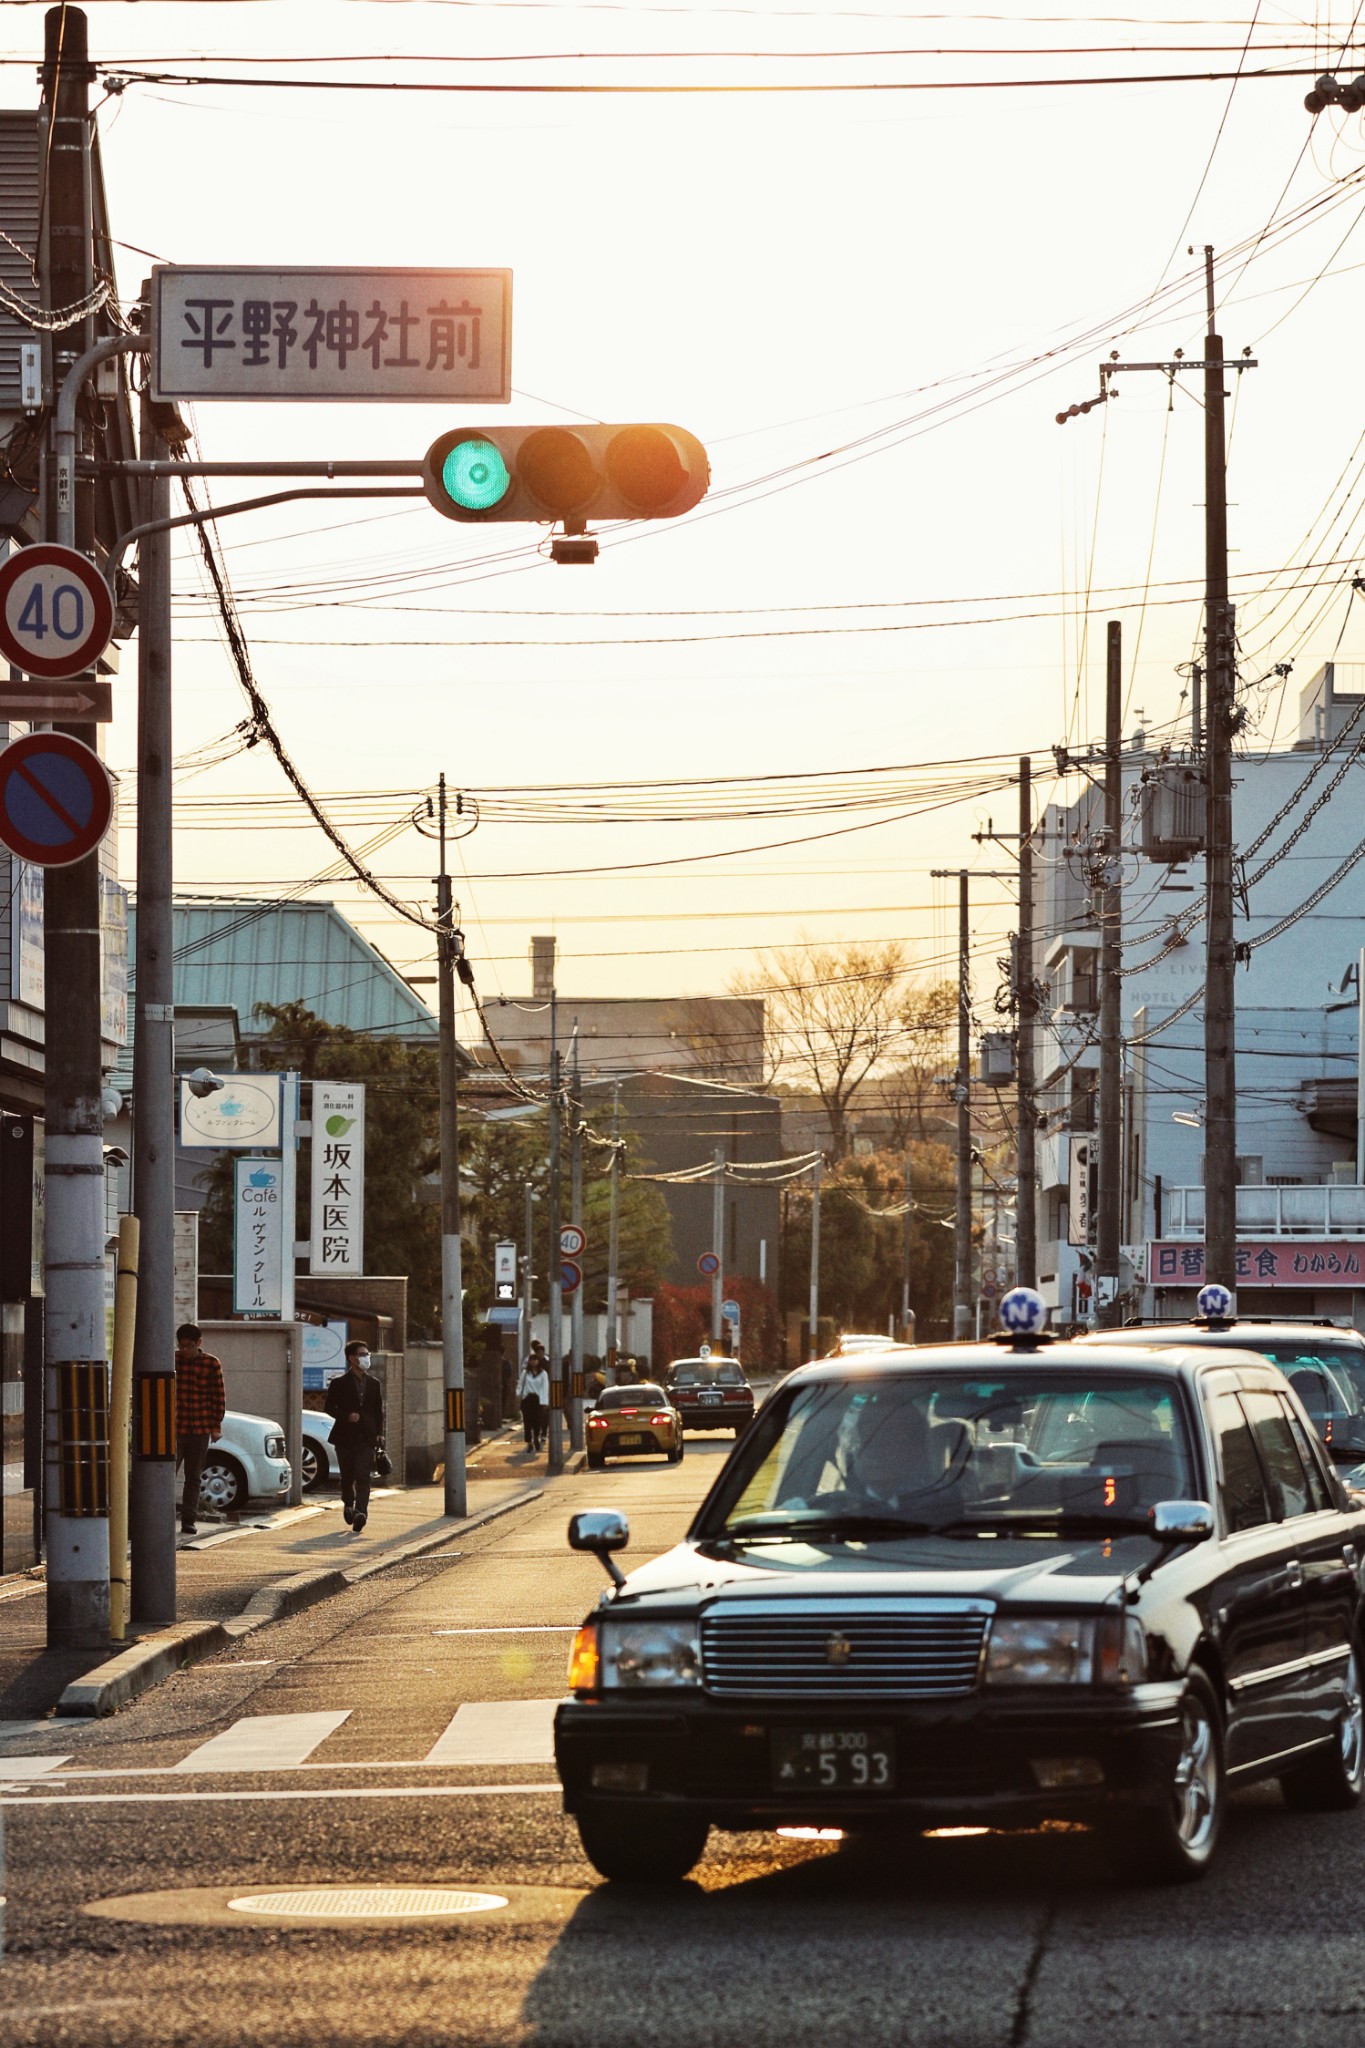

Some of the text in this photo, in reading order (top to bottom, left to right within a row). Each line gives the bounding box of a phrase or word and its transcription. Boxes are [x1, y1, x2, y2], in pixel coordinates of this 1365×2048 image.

[181, 298, 482, 371] 平野神社前
[17, 583, 84, 641] 40
[242, 1188, 278, 1204] Café
[322, 1143, 352, 1263] 坂本医院
[561, 1235, 579, 1250] 40
[1159, 1248, 1279, 1278] 日替定食
[1293, 1251, 1360, 1275] わからん
[1007, 1302, 1029, 1323] N
[1207, 1294, 1222, 1310] N
